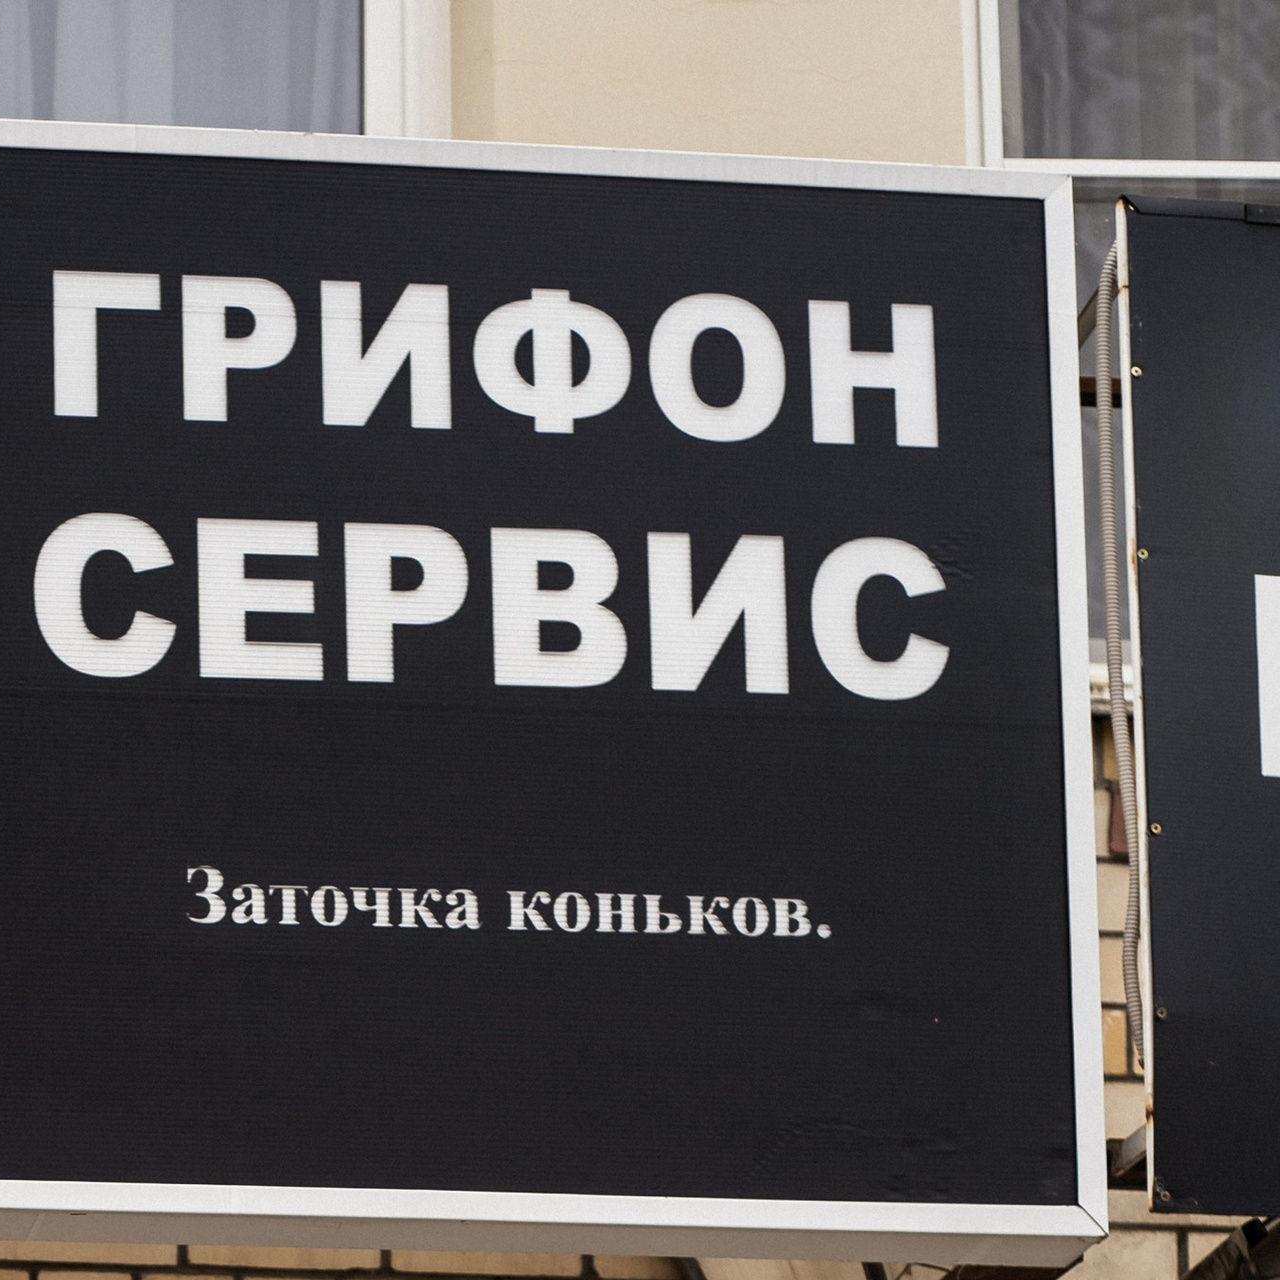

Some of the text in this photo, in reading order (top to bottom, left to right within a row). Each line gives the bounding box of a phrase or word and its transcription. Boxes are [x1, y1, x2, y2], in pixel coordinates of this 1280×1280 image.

[52, 270, 939, 449] ГРИФОН
[32, 512, 950, 701] СЕРВИС
[185, 863, 833, 940] Заточка коньков.
